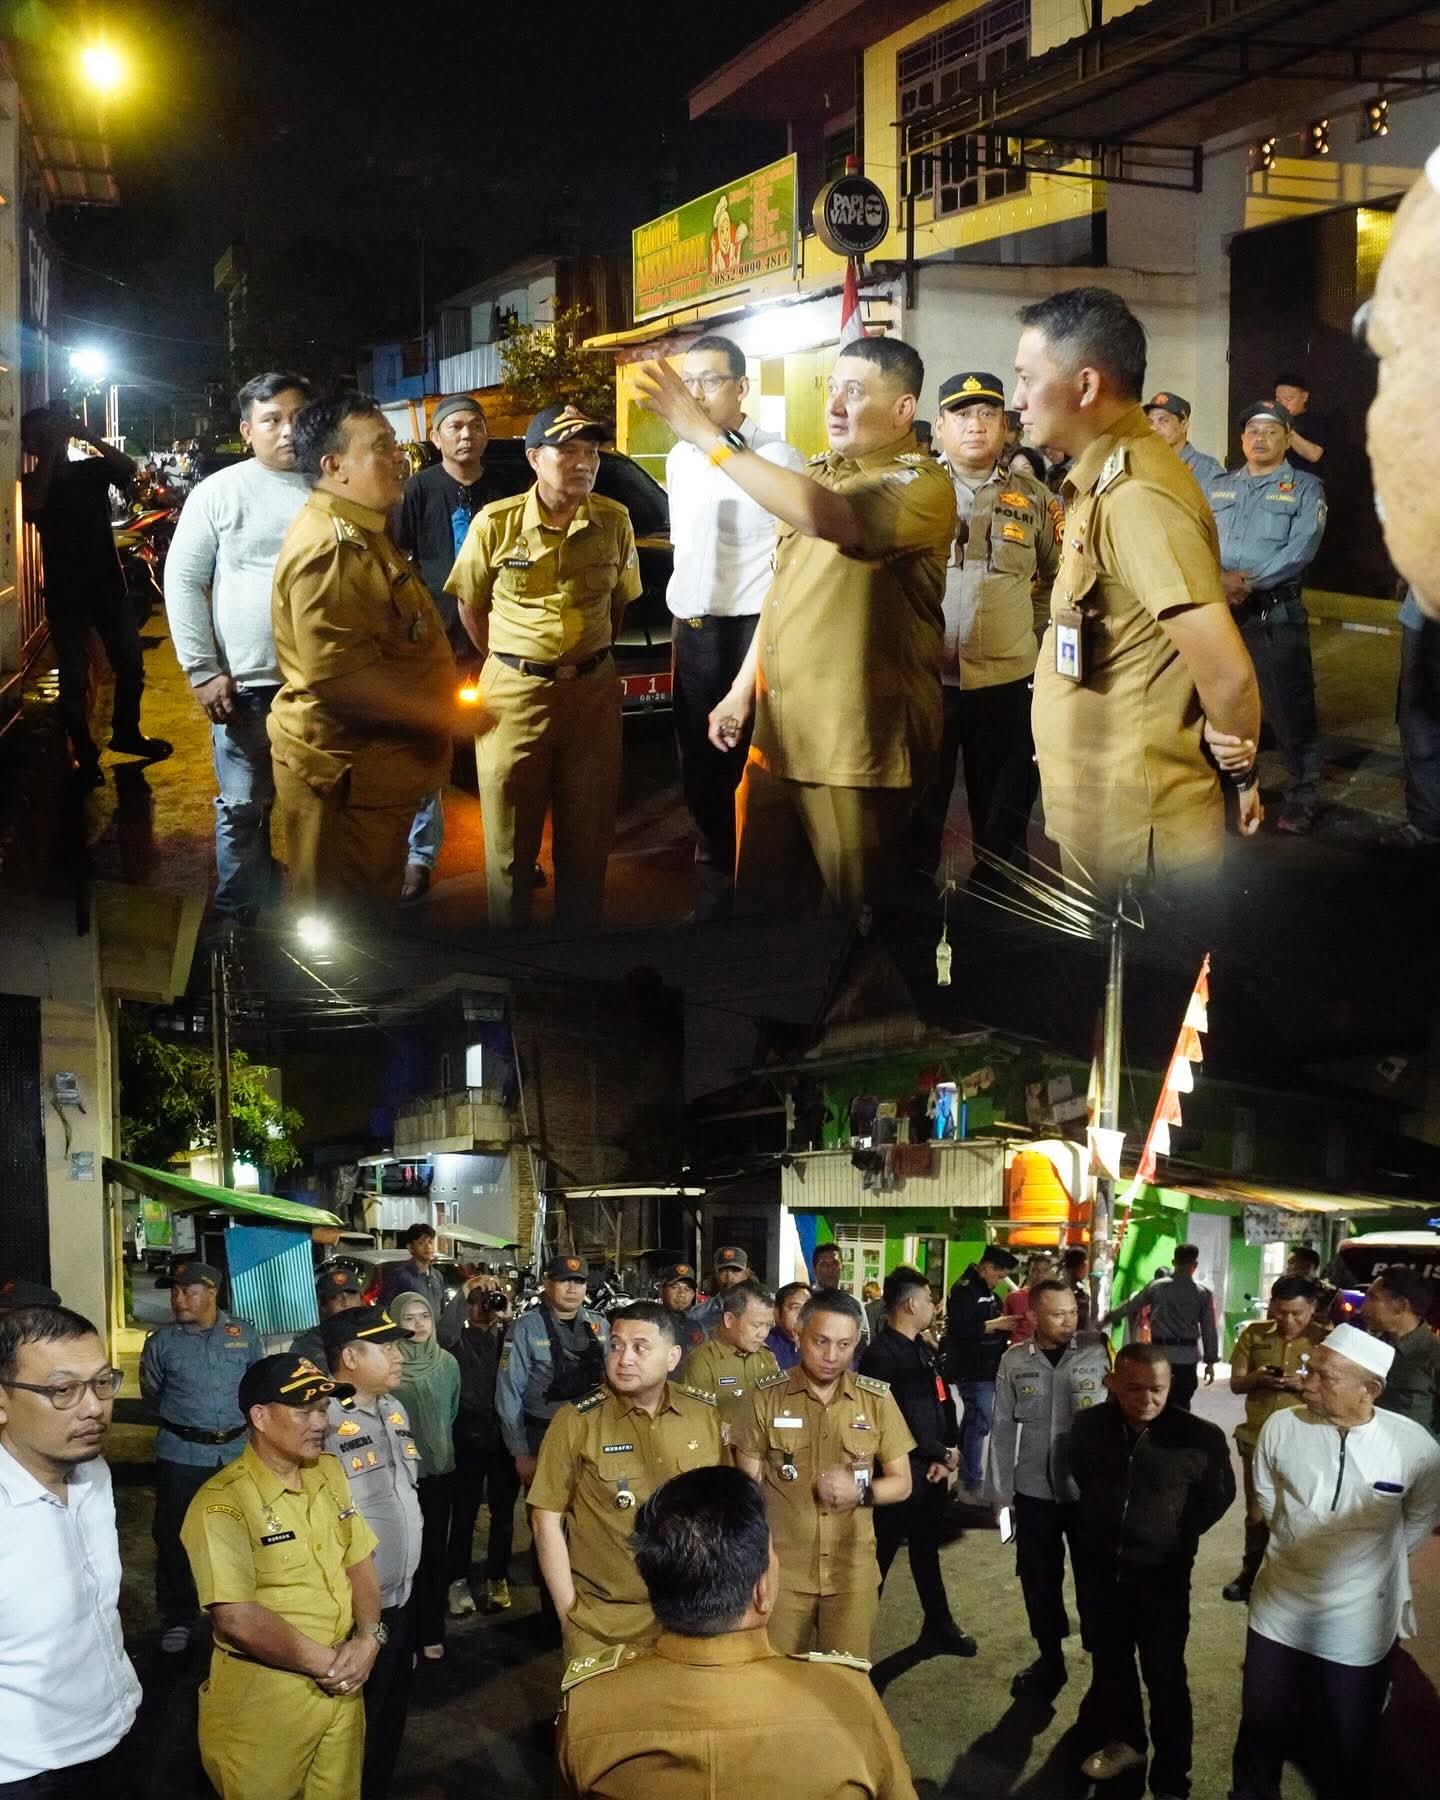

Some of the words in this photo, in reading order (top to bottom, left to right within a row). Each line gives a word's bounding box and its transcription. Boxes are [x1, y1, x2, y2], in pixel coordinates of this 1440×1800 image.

[833, 193, 864, 209] PAPI
[830, 208, 865, 226] VAPE
[994, 506, 1034, 525] POLRI
[303, 1382, 336, 1402] PO
